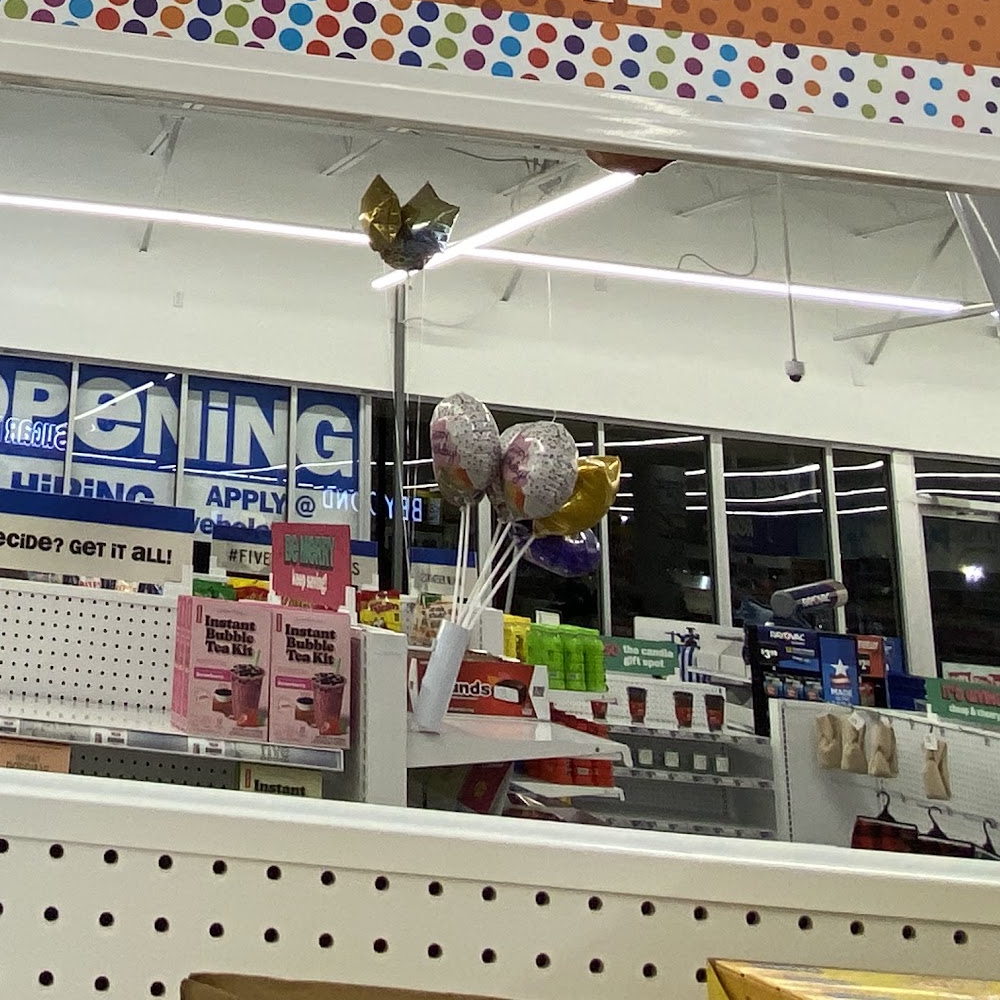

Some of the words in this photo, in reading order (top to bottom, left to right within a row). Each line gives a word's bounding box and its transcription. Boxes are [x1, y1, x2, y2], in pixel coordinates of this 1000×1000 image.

[206, 485, 286, 515] APPLY
[205, 615, 256, 631] Instant
[205, 628, 254, 643] Bubble
[285, 624, 336, 640] Instant
[205, 641, 230, 654] Tea
[232, 644, 253, 656] Kit
[286, 637, 334, 652] Bubble
[622, 644, 639, 655] the
[641, 648, 674, 658] candle
[286, 650, 310, 662] Tea
[313, 652, 334, 664] Kit
[623, 656, 641, 667] gift
